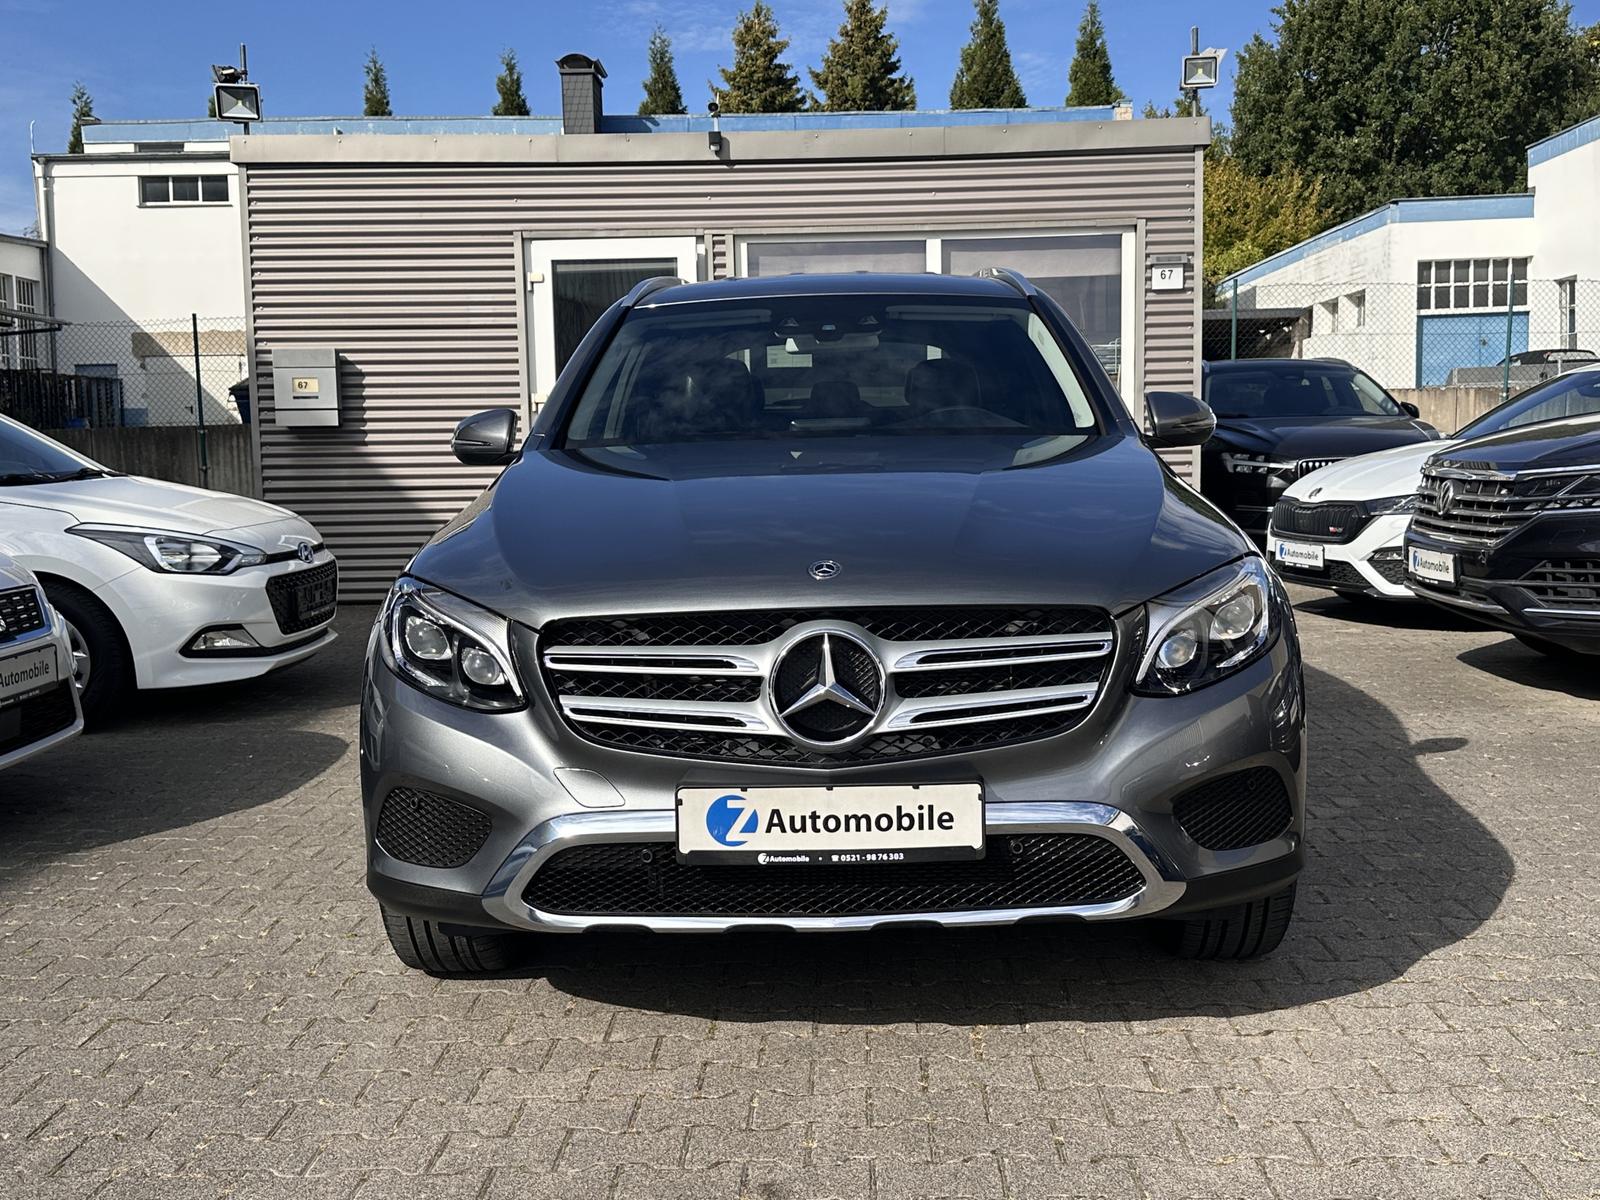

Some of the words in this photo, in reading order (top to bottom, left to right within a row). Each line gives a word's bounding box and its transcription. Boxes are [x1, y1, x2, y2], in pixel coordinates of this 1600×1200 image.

[1160, 269, 1174, 280] 67
[297, 381, 308, 389] 67
[1287, 548, 1319, 560] Automobile
[1420, 557, 1450, 573] Automobile
[765, 804, 954, 834] Automobile
[840, 854, 861, 862] 0521
